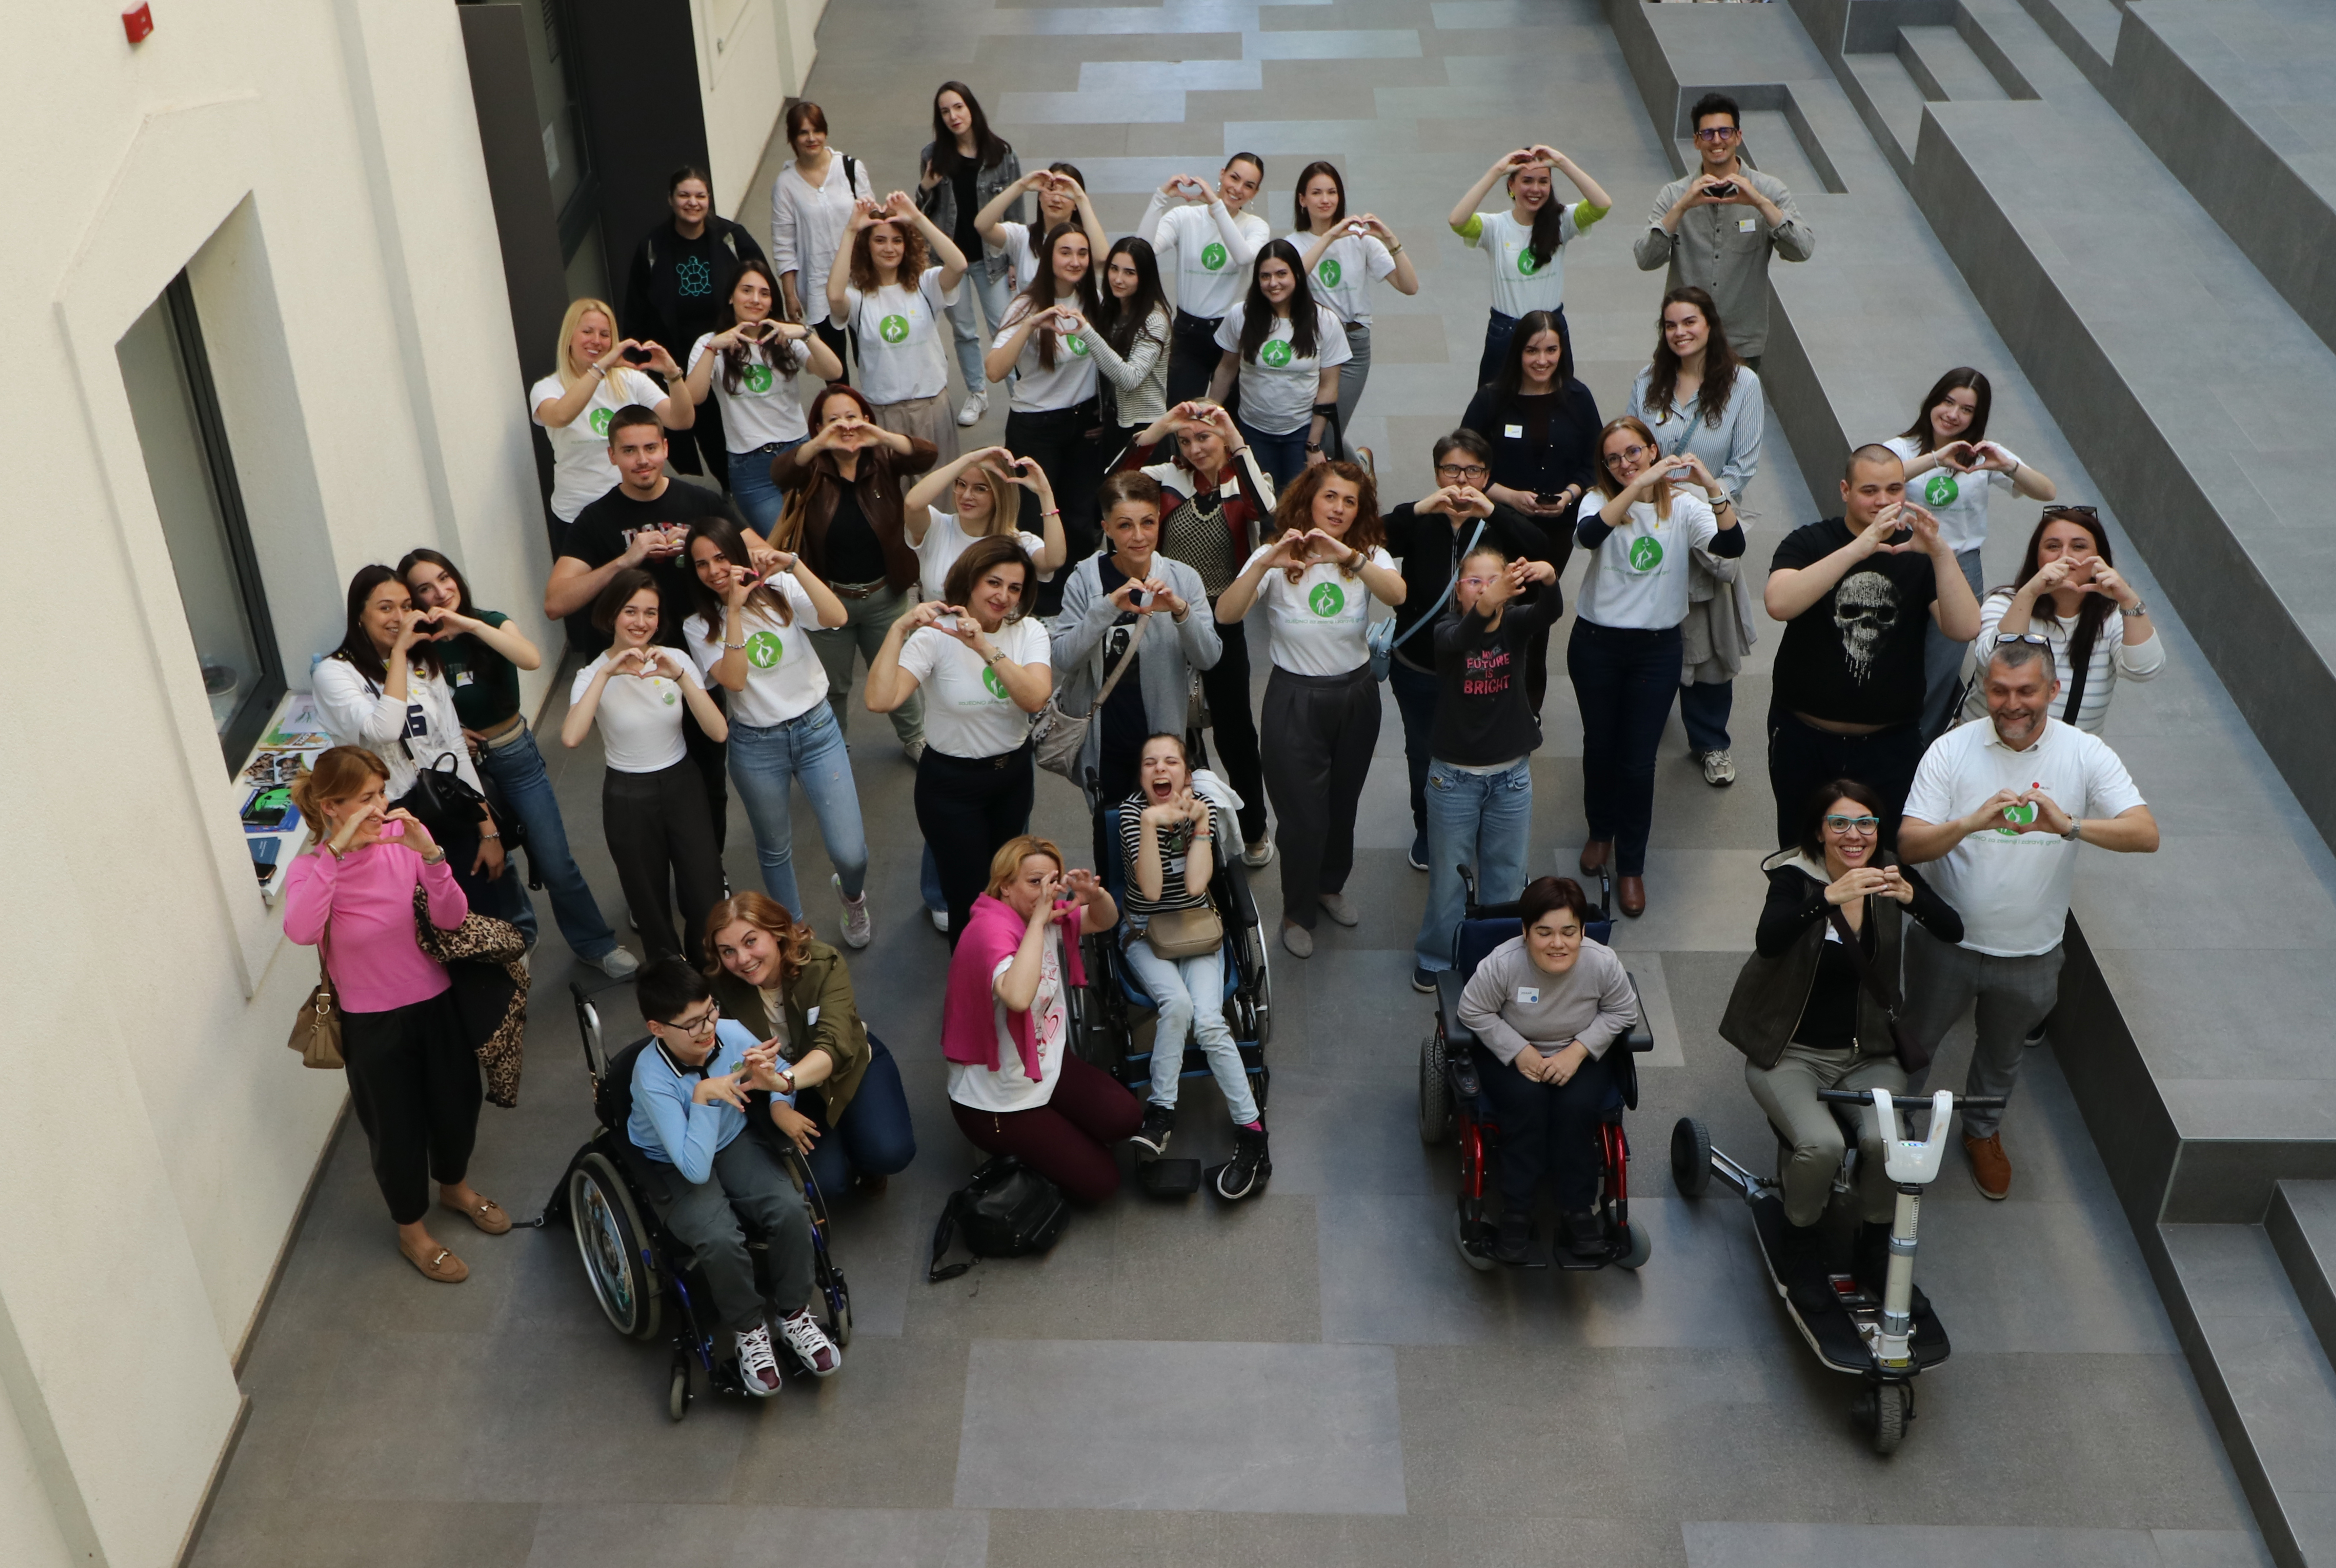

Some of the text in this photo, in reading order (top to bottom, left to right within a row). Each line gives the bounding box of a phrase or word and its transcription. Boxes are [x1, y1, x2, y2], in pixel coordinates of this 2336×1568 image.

[1467, 653, 1511, 669] FUTURE
[1482, 650, 1493, 659] MY
[1485, 669, 1493, 679] IS
[1464, 675, 1511, 695] BRIGHT
